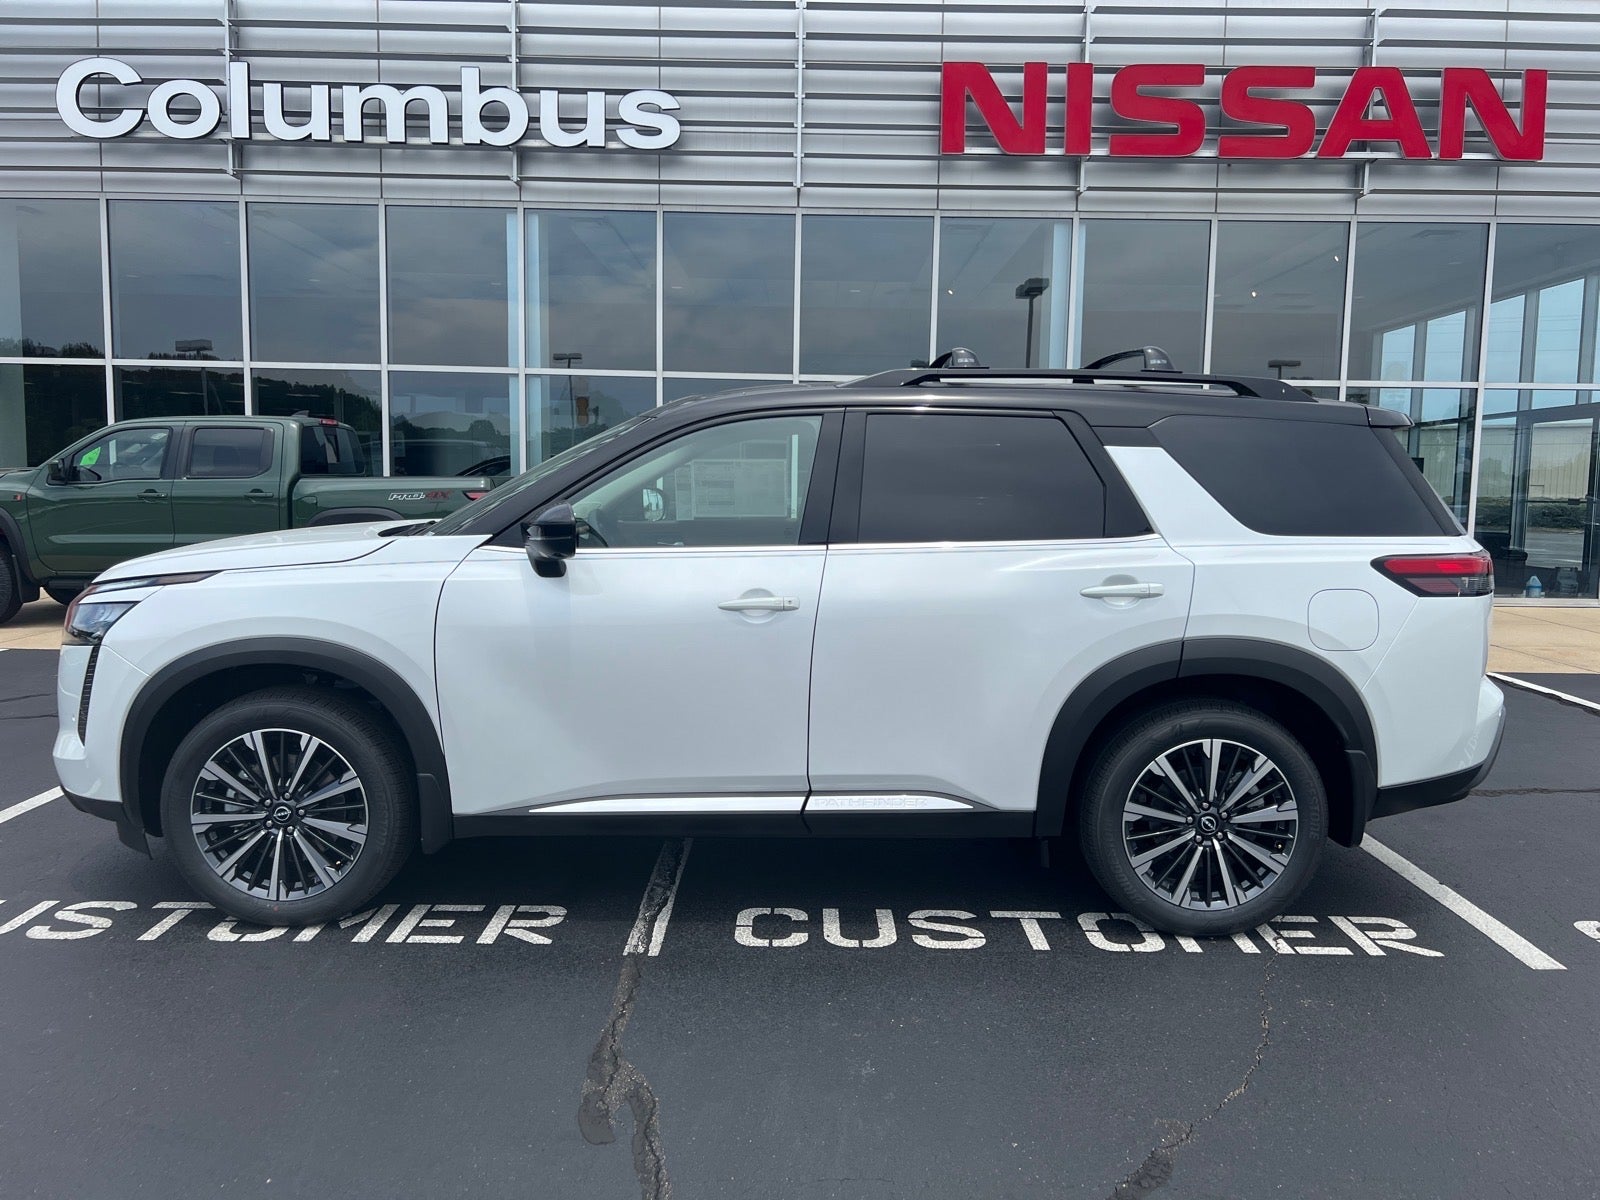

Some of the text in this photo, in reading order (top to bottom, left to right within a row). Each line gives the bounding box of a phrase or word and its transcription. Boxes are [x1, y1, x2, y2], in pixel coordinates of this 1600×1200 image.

[56, 57, 681, 150] Columbus
[941, 61, 1548, 162] NISSAN
[814, 797, 929, 808] PATHFINDER
